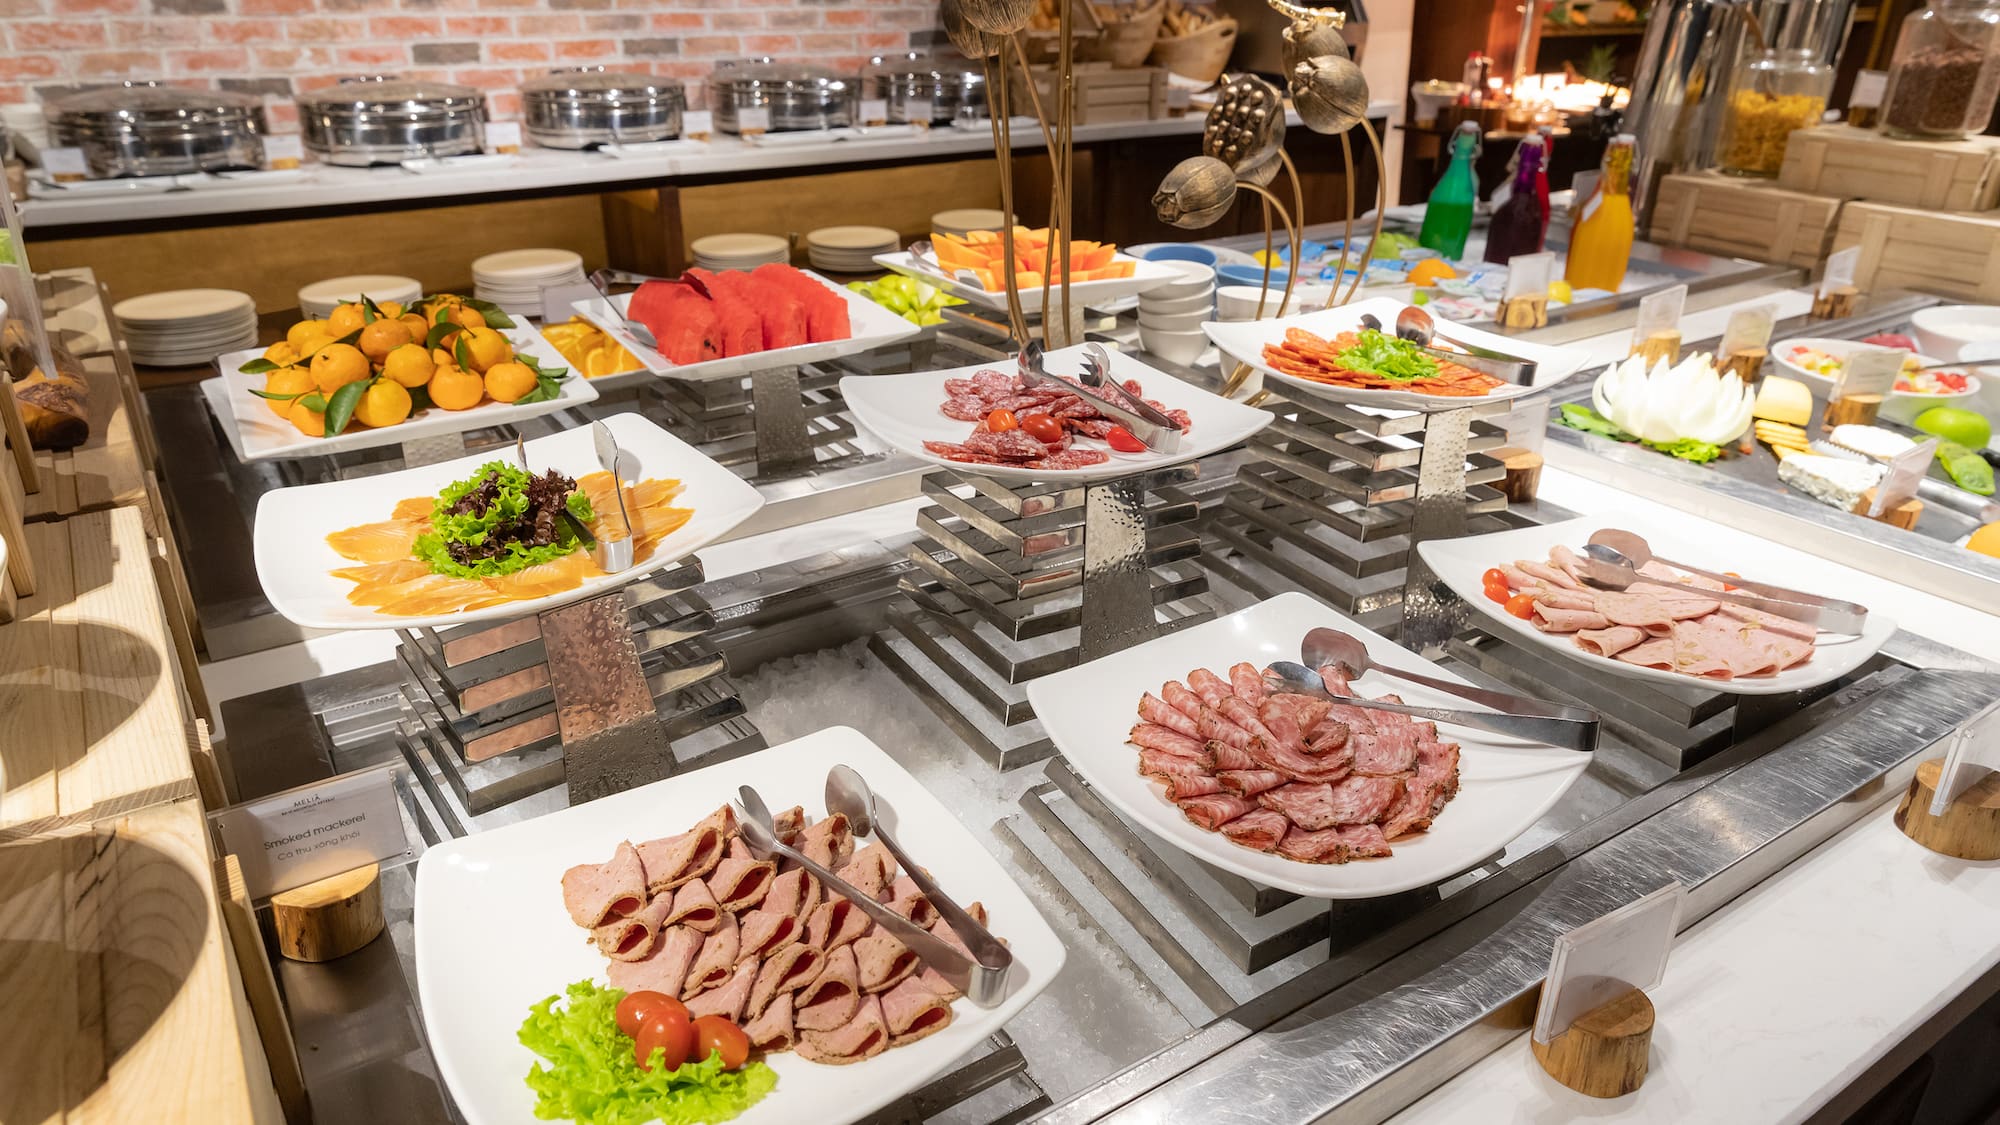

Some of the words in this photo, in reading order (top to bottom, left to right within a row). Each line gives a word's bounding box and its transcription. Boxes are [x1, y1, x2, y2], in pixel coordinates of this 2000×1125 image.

[264, 831, 312, 850] Smoked
[313, 812, 366, 836] mackerel
[296, 846, 312, 856] thu
